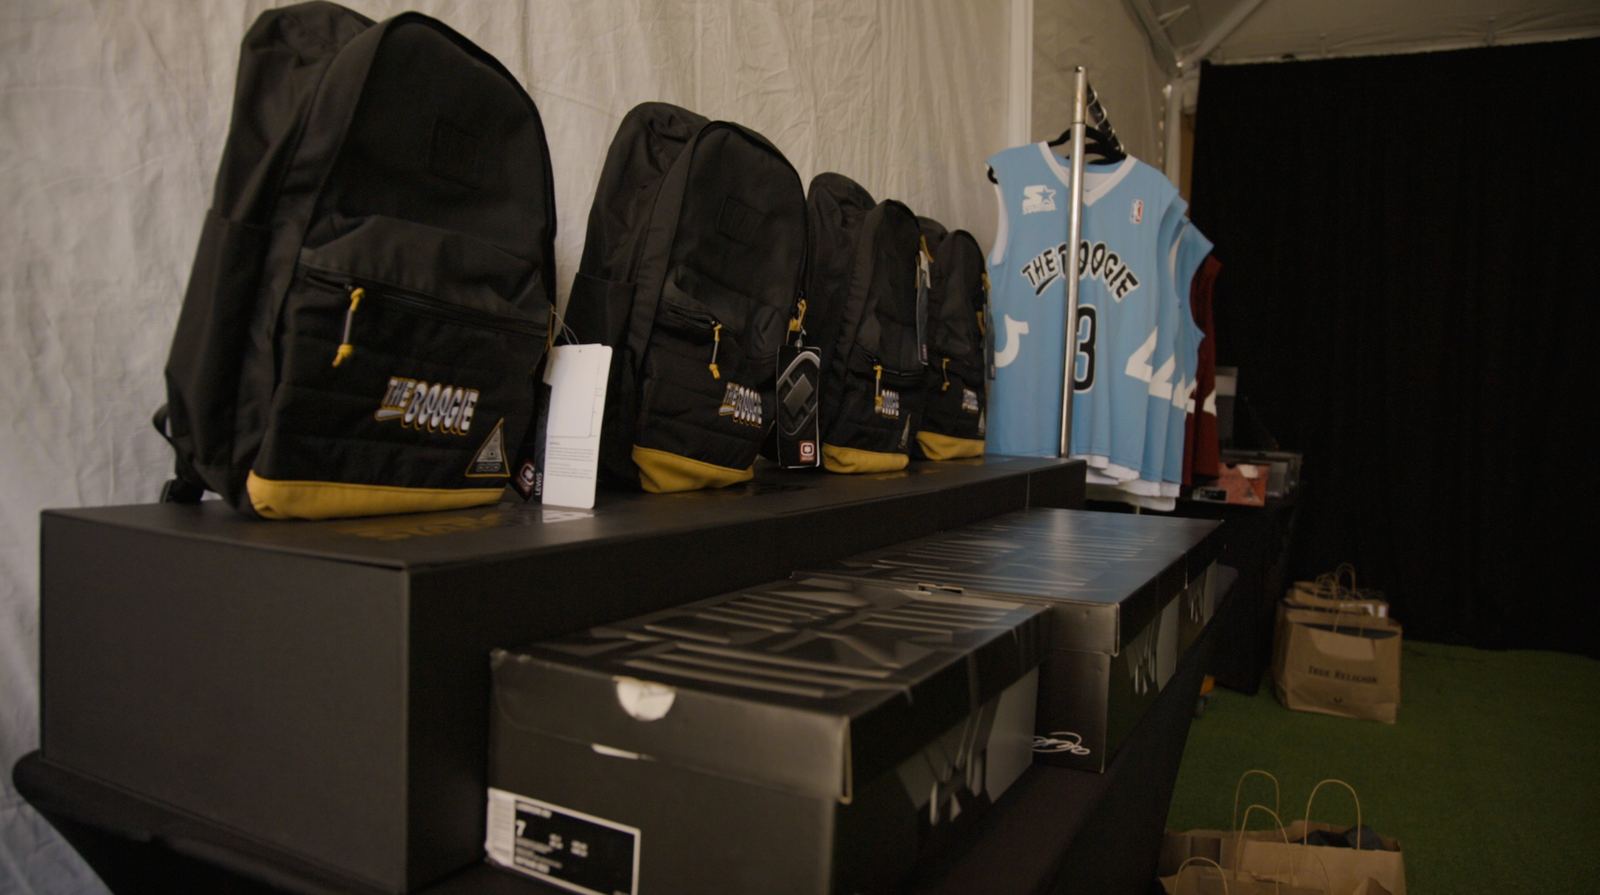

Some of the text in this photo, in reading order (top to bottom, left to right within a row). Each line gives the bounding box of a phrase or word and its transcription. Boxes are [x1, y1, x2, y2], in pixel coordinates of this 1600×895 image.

[1021, 248, 1057, 287] THE
[380, 376, 480, 436] THE BOOGIE
